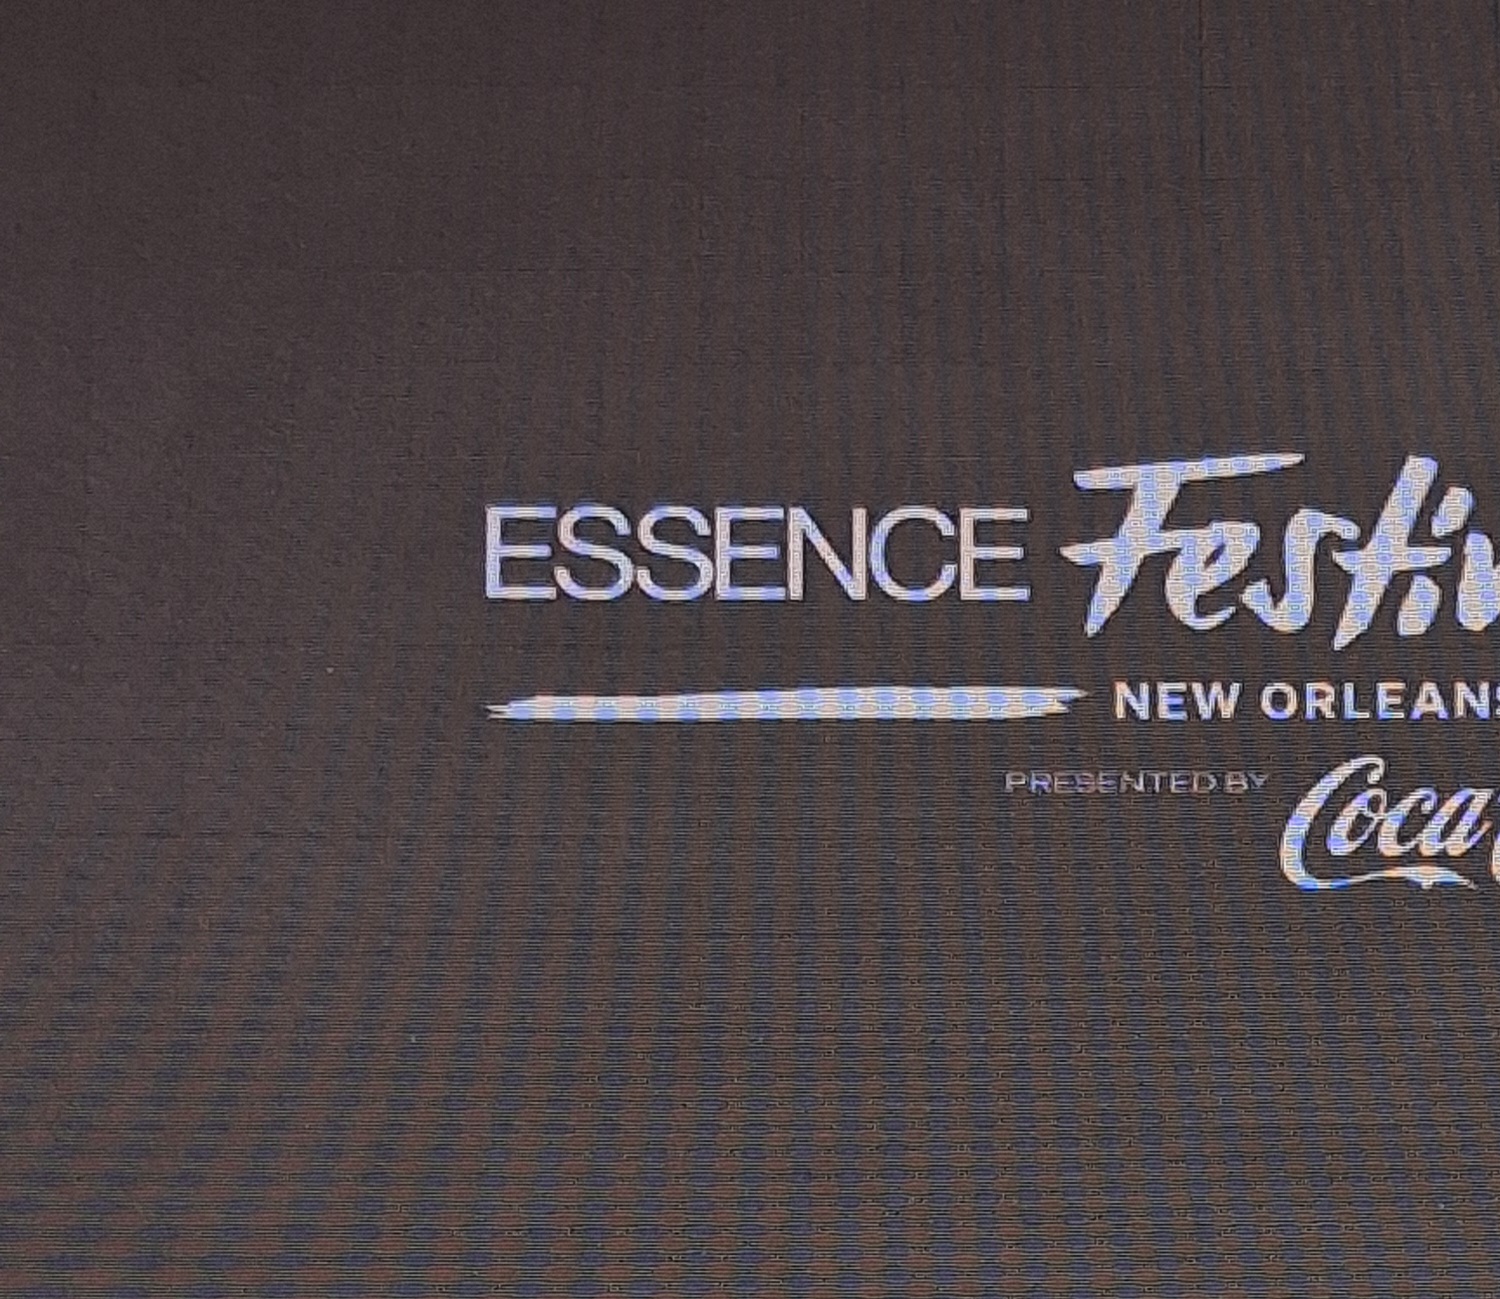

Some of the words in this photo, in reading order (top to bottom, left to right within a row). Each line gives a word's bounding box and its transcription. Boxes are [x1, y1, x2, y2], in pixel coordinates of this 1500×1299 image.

[484, 504, 1031, 601] ESSENCE
[1113, 681, 1241, 721] NEW
[1005, 769, 1217, 794] PRESENTED
[1224, 770, 1270, 794] BY
